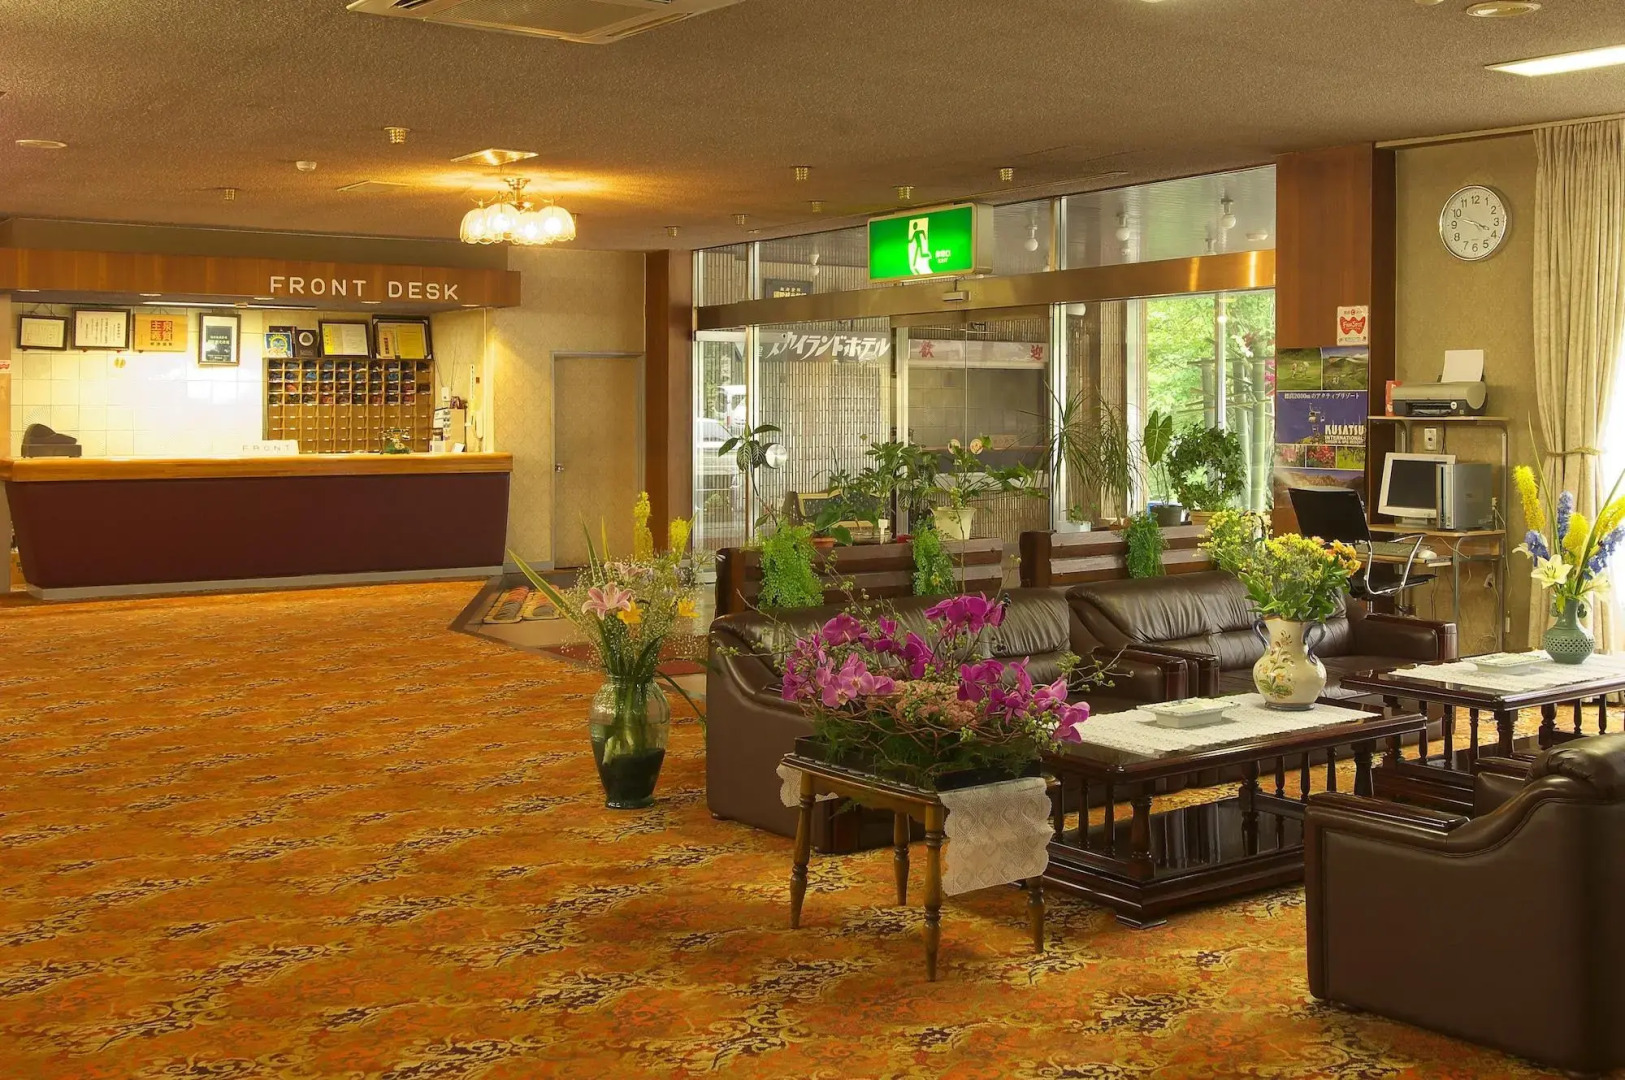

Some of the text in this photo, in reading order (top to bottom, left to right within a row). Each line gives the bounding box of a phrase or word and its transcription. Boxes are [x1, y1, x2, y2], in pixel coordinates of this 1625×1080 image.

[1461, 199, 1467, 208] 11
[1471, 195, 1480, 204] 12
[1453, 209, 1461, 217] 10
[1491, 206, 1496, 214] 2
[1451, 221, 1457, 229] 9
[1494, 218, 1499, 226] 3
[1454, 233, 1460, 241] 8
[1491, 231, 1496, 239] 4
[1463, 241, 1468, 250] 7
[1472, 243, 1478, 252] 6
[1483, 240, 1489, 248] 5
[270, 276, 459, 300] FRONT DESK
[1325, 424, 1364, 435] KUSATSU
